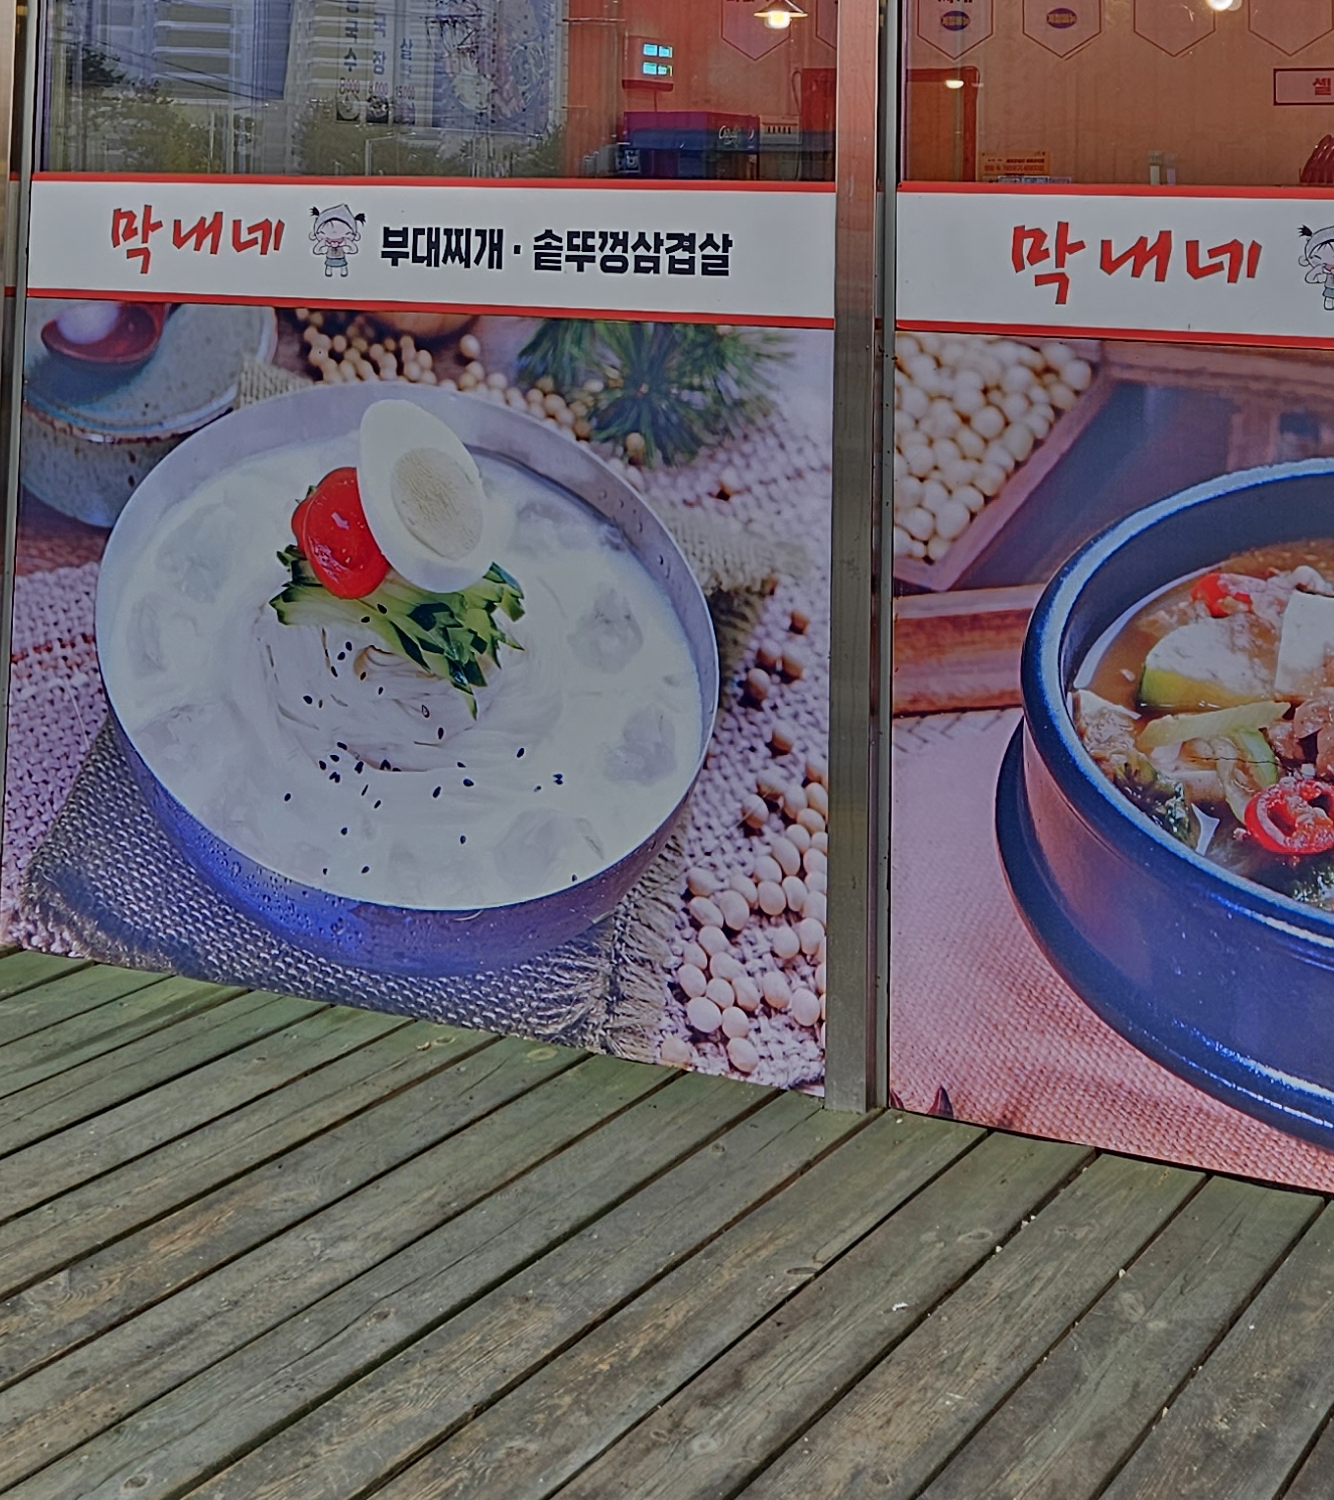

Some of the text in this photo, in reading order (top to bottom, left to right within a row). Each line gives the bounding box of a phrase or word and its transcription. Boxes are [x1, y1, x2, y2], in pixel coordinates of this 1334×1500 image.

[111, 204, 734, 278] 막내네 부대찌개 솥뚜껑삼겹살
[1010, 222, 1262, 305] 막내네
